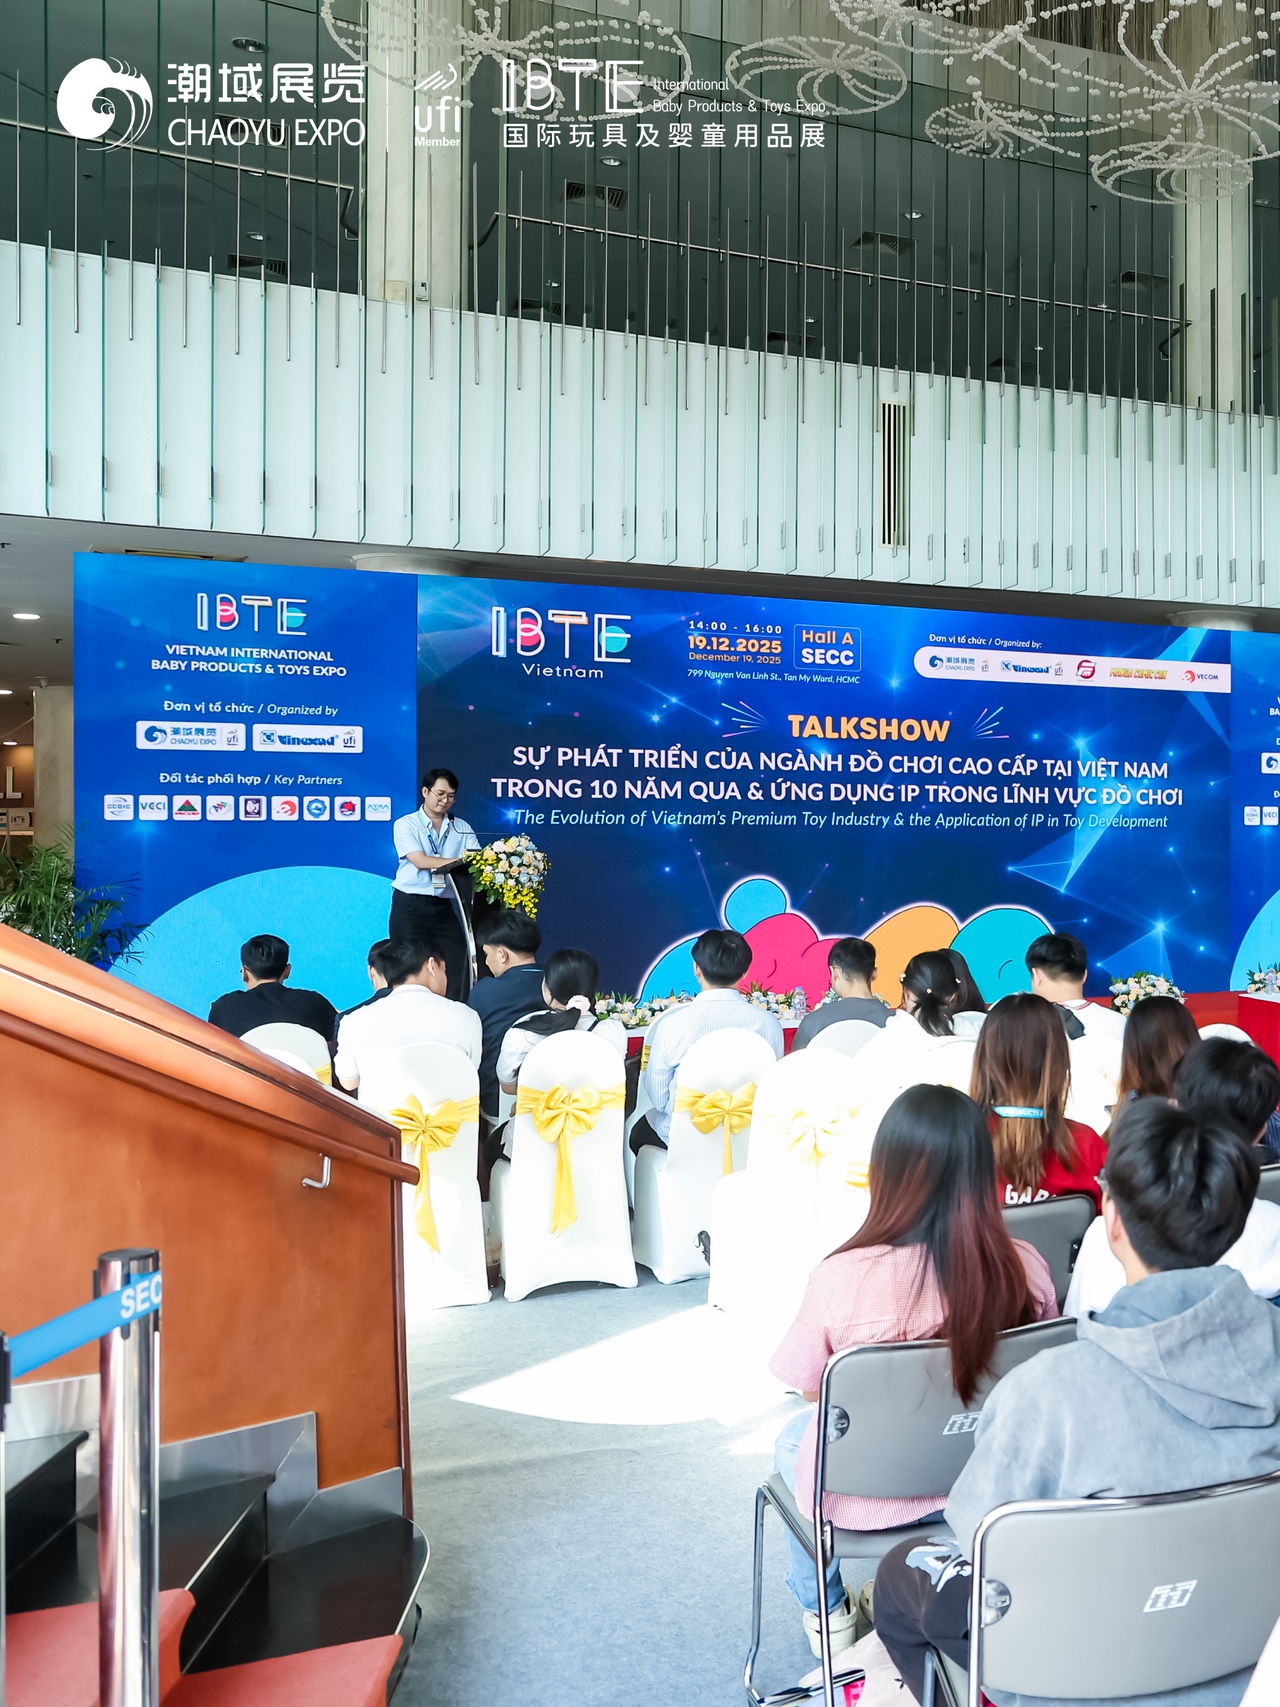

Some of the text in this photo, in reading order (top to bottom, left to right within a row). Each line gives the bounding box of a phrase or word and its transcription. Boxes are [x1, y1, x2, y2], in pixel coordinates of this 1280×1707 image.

[196, 592, 308, 637] IBTE
[491, 606, 632, 664] IBTE
[688, 620, 782, 635] 14:00 16:00
[687, 635, 783, 654] 19.12.2025
[802, 629, 854, 645] Hall A
[165, 644, 334, 661] VIETNAM INTERNATIONAL
[688, 651, 782, 665] December 19, 2025
[801, 647, 855, 666] SECC
[151, 659, 347, 677] BABY PRODUCTS & TOYS EXPO
[521, 662, 604, 679] Vietnam
[687, 668, 861, 684] 799 Nguyen Van Linh St., Tan My Ward, HCMC
[163, 700, 339, 717] Đơn vị tổ chức Organized by
[786, 714, 952, 743] TALKSHOW
[512, 745, 1168, 781] SỰ PHÁT TRIỂN CỦA NGÀNH ĐỒ CHƠI CAO CẤP TẠI VIỆT NAM
[159, 772, 343, 786] Đối tác phối hợp Key Partners
[490, 777, 1183, 808] TRONG 10 NĂM QUA & ỨNG DỤNG IP TRONG LĨNH VỰC ĐỒ CHƠI
[514, 808, 545, 825] The
[550, 809, 626, 825] Evolution
[630, 810, 648, 827] of
[731, 810, 797, 826] Premium
[801, 811, 828, 829] Toy
[831, 811, 891, 829] Industry
[893, 812, 905, 826] &
[909, 812, 932, 827] the
[934, 813, 1010, 829] Application
[1013, 813, 1028, 829] of
[1031, 814, 1044, 827] IP
[1047, 814, 1059, 827] in
[1062, 814, 1085, 830] Toy
[1087, 814, 1169, 831] Development
